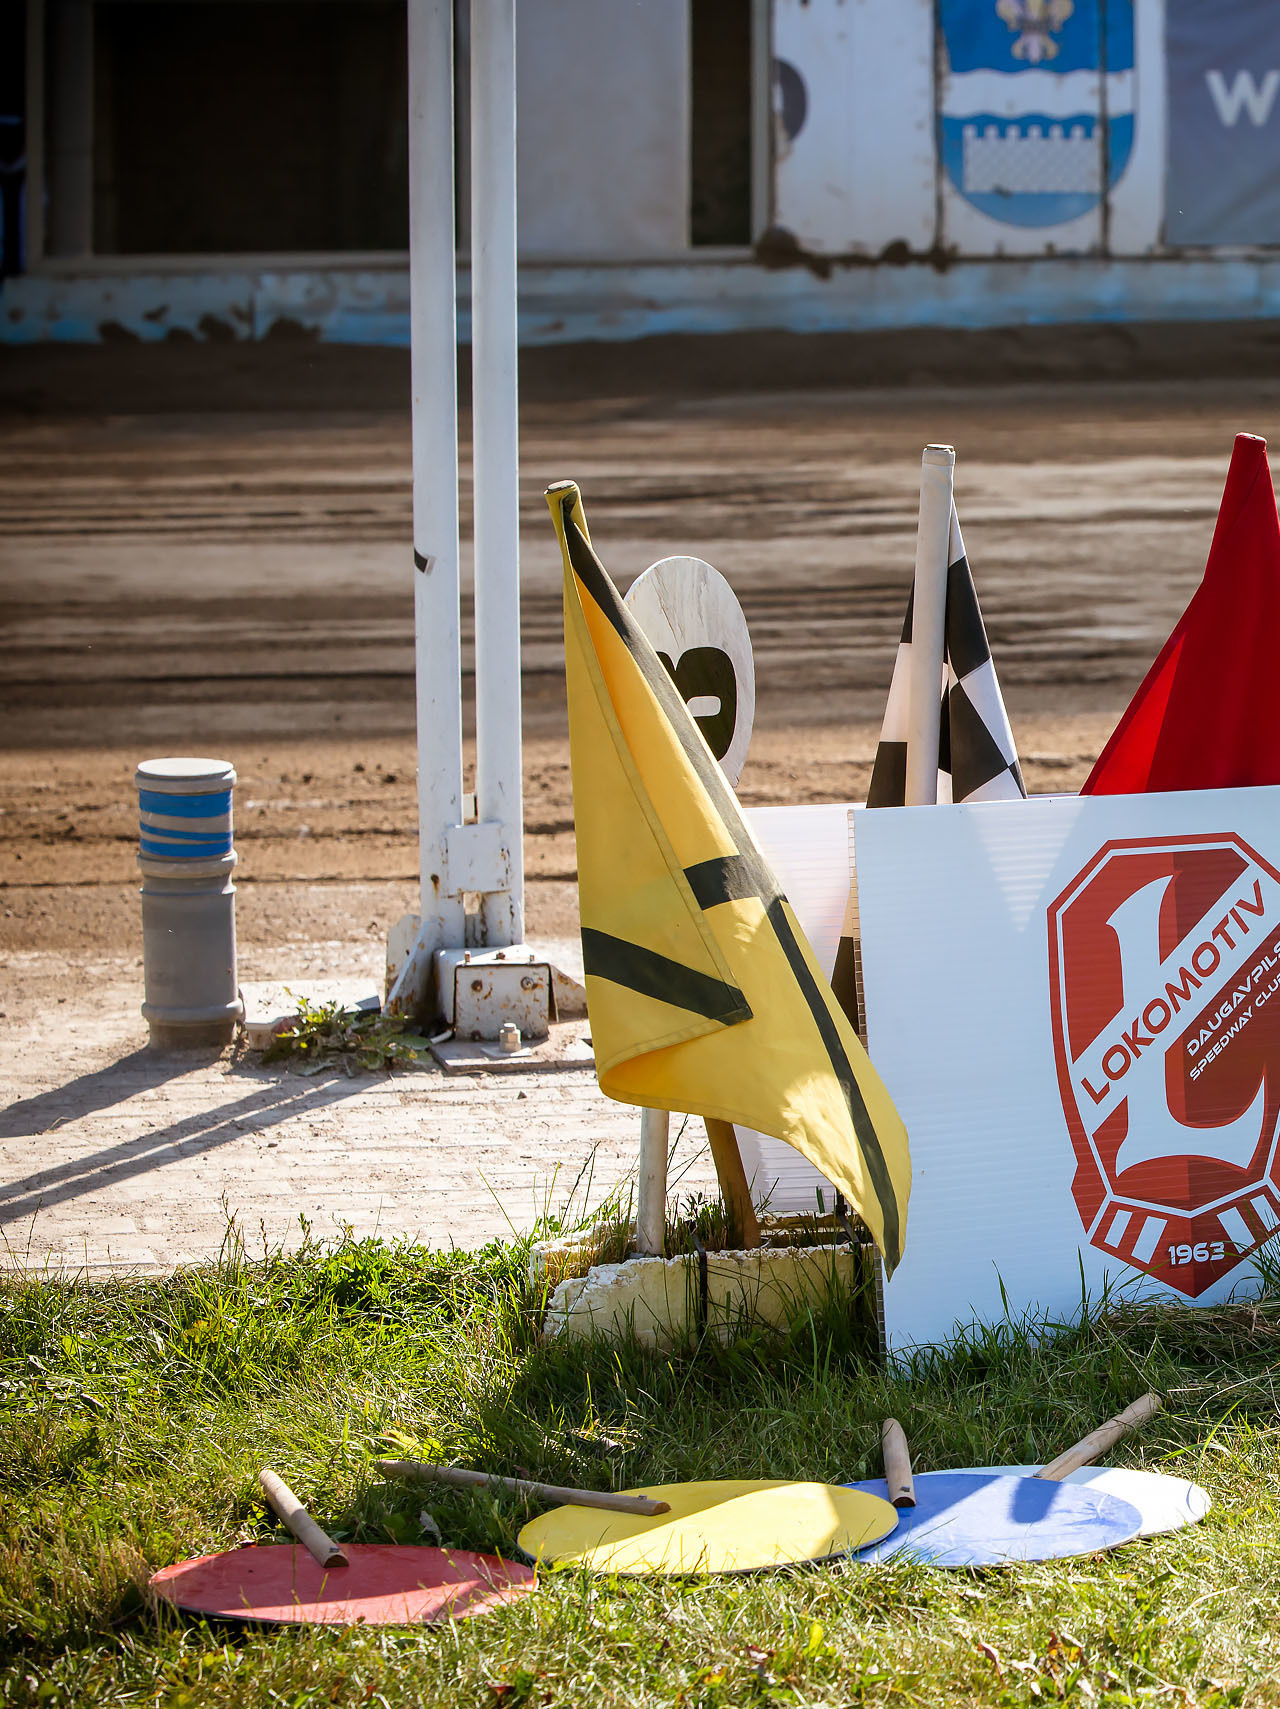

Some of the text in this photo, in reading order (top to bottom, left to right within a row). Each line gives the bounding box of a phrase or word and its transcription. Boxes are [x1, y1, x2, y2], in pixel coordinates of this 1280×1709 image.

[1080, 878, 1265, 1105] LOKOMOTIV
[1189, 1005, 1253, 1081] SPEEDWAY
[1168, 1241, 1225, 1265] 1963
